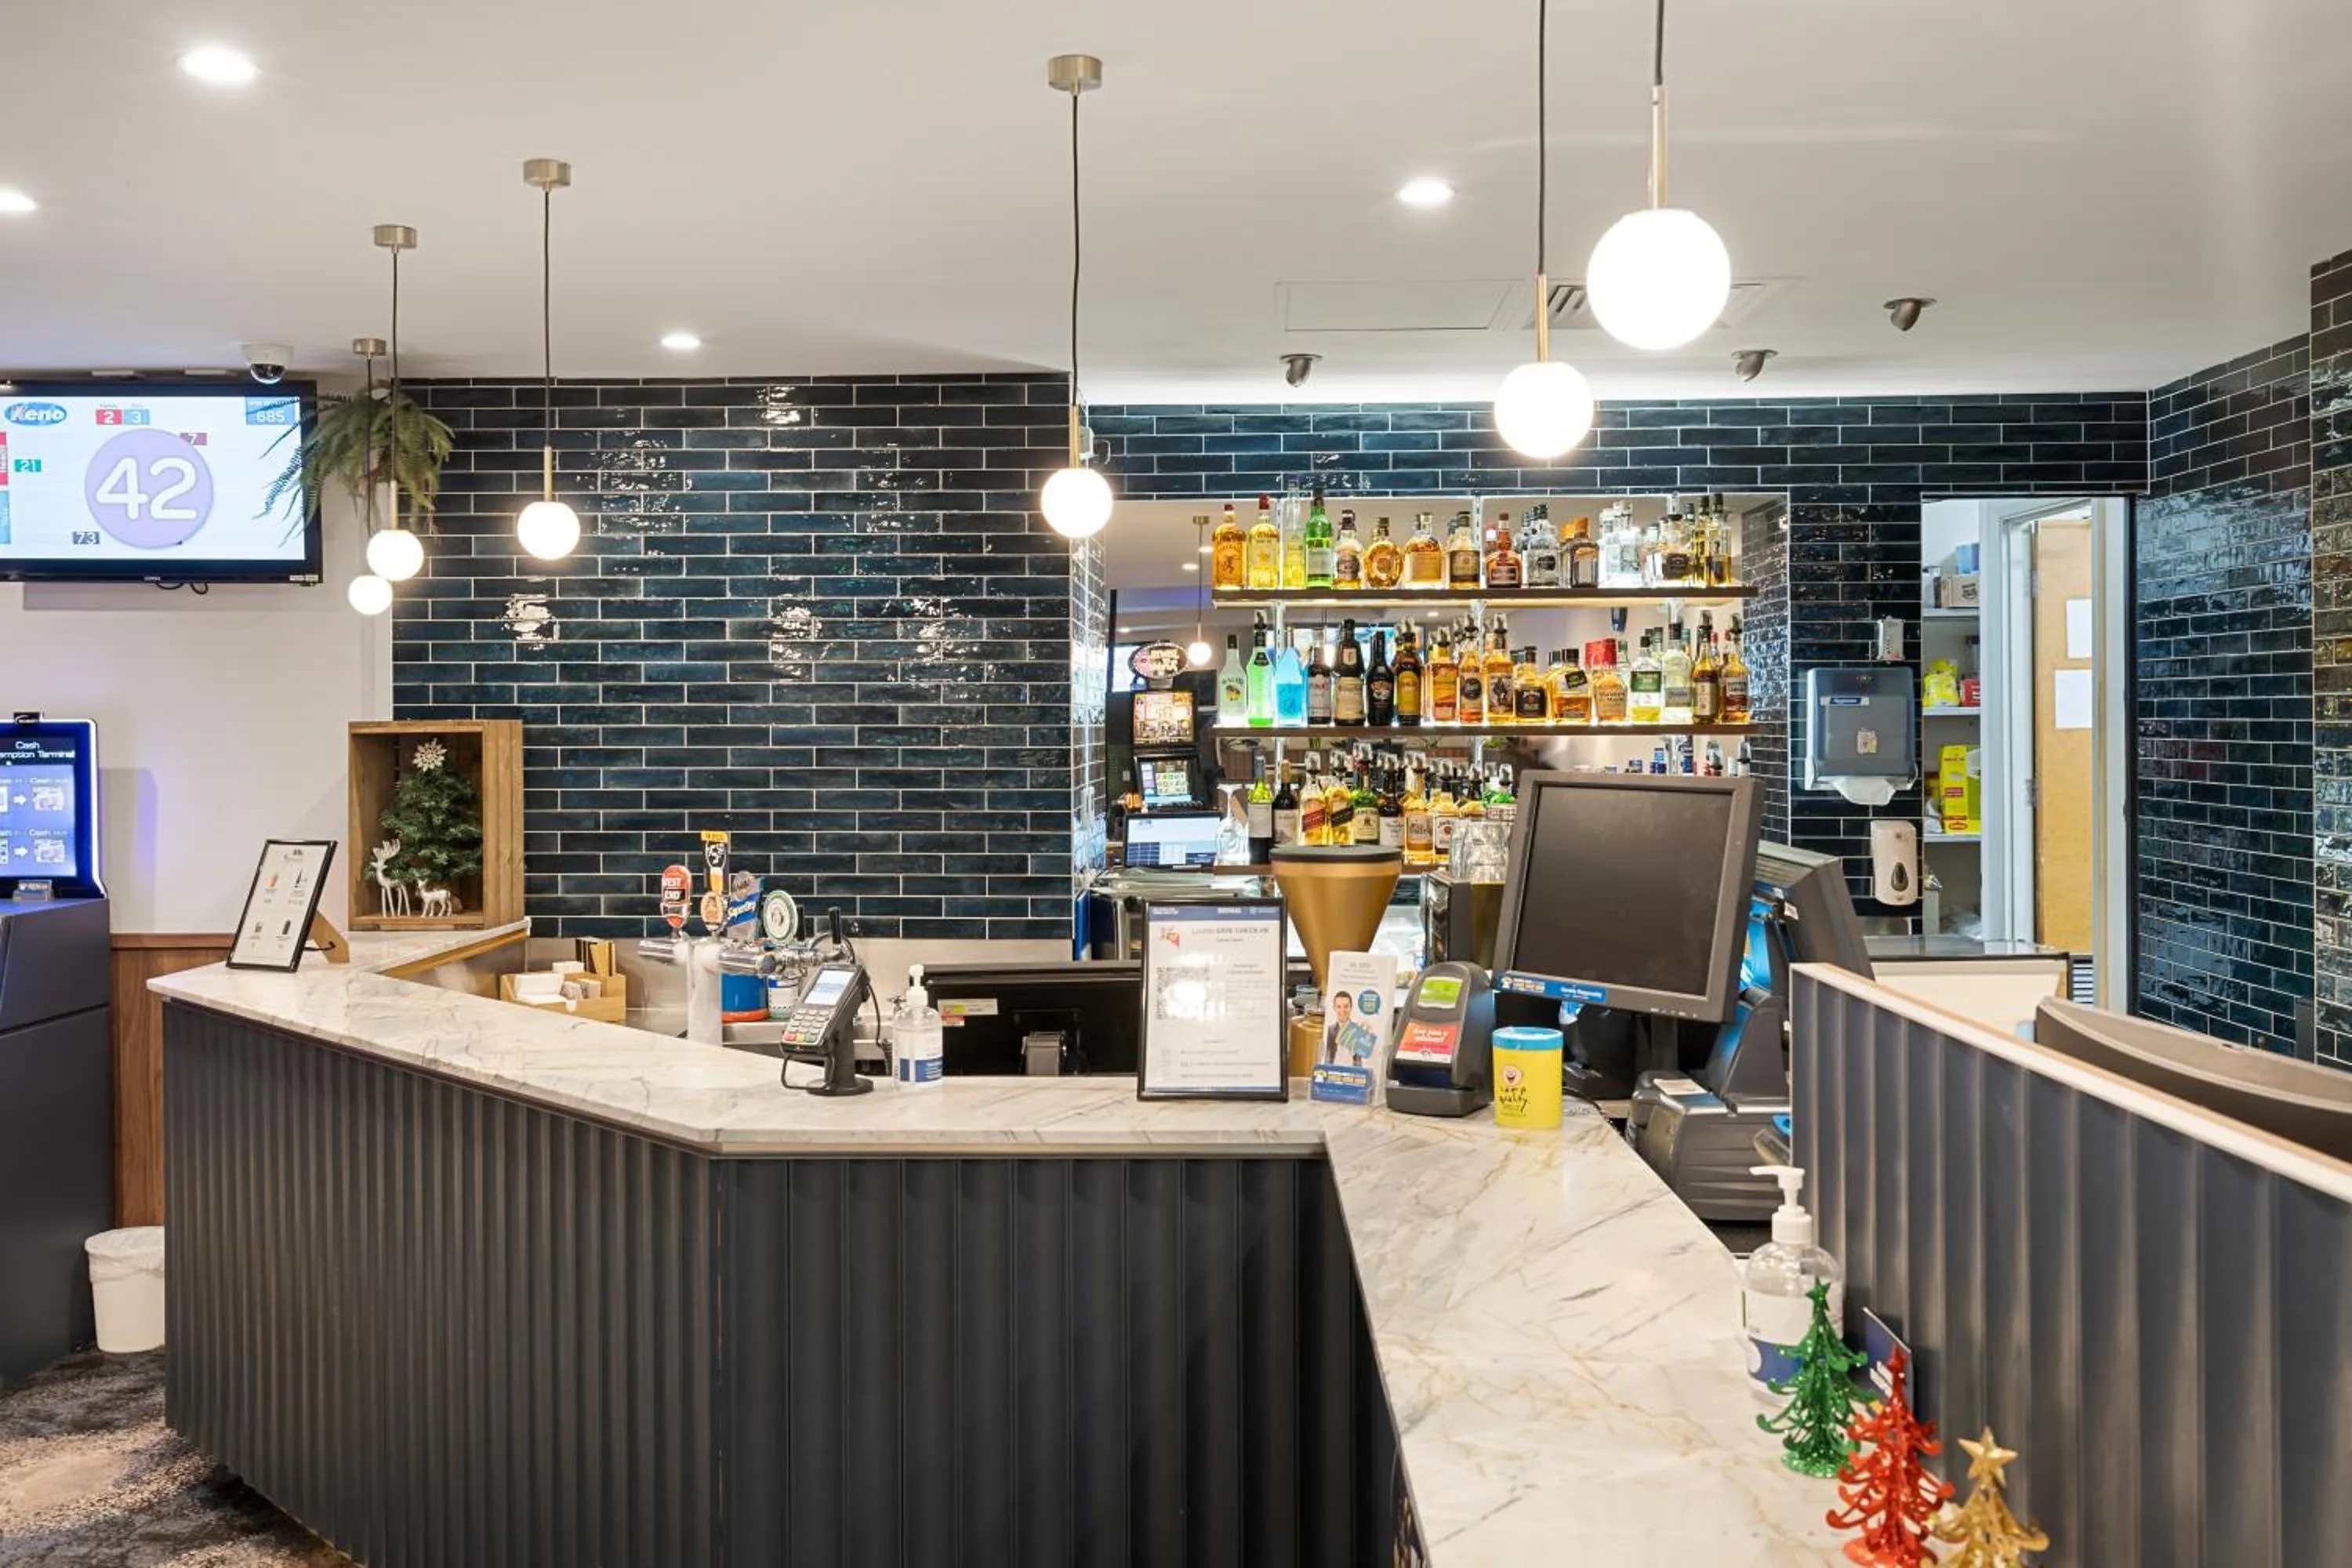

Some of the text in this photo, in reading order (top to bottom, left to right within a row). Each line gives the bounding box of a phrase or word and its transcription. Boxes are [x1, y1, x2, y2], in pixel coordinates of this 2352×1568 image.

[10, 405, 65, 422] Keno
[103, 411, 115, 424] 2
[132, 411, 142, 424] 3
[256, 410, 286, 423] 685
[20, 459, 37, 471] 21
[96, 456, 198, 521] 42
[76, 532, 96, 544] 73
[15, 741, 40, 750] Cash
[38, 750, 75, 758] Terminal
